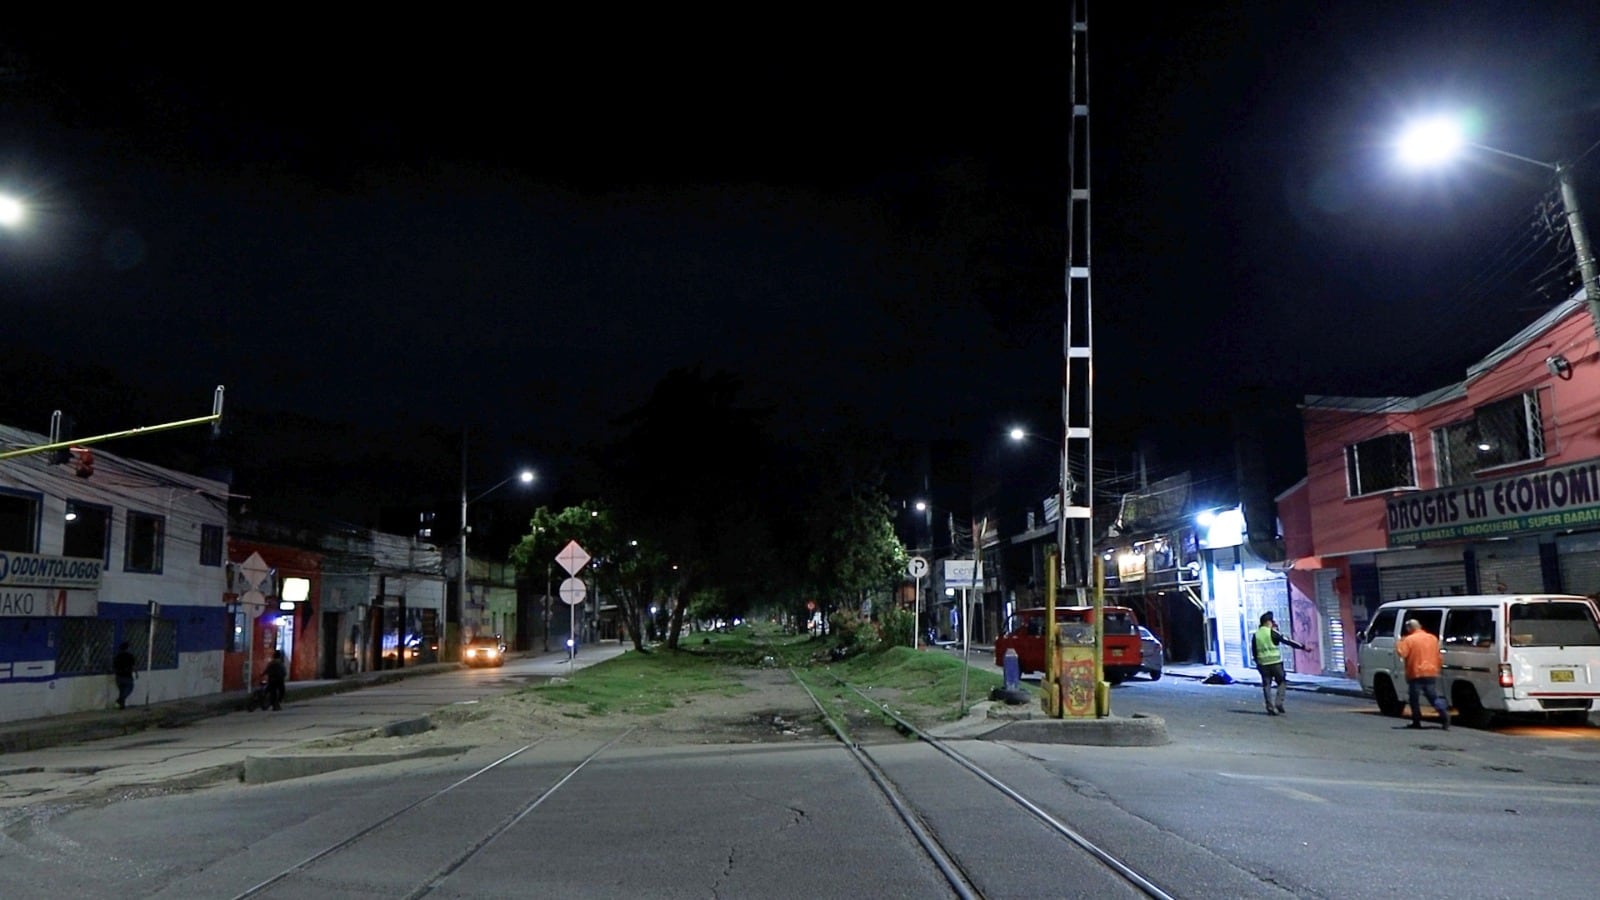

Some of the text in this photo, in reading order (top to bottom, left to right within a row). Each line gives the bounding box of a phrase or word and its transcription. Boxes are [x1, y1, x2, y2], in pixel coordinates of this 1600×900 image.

[1387, 491, 1459, 530] DROGAS
[1464, 485, 1487, 518] LA
[1528, 514, 1561, 529] SUPER
[11, 557, 100, 579] ODONTOLOGOS
